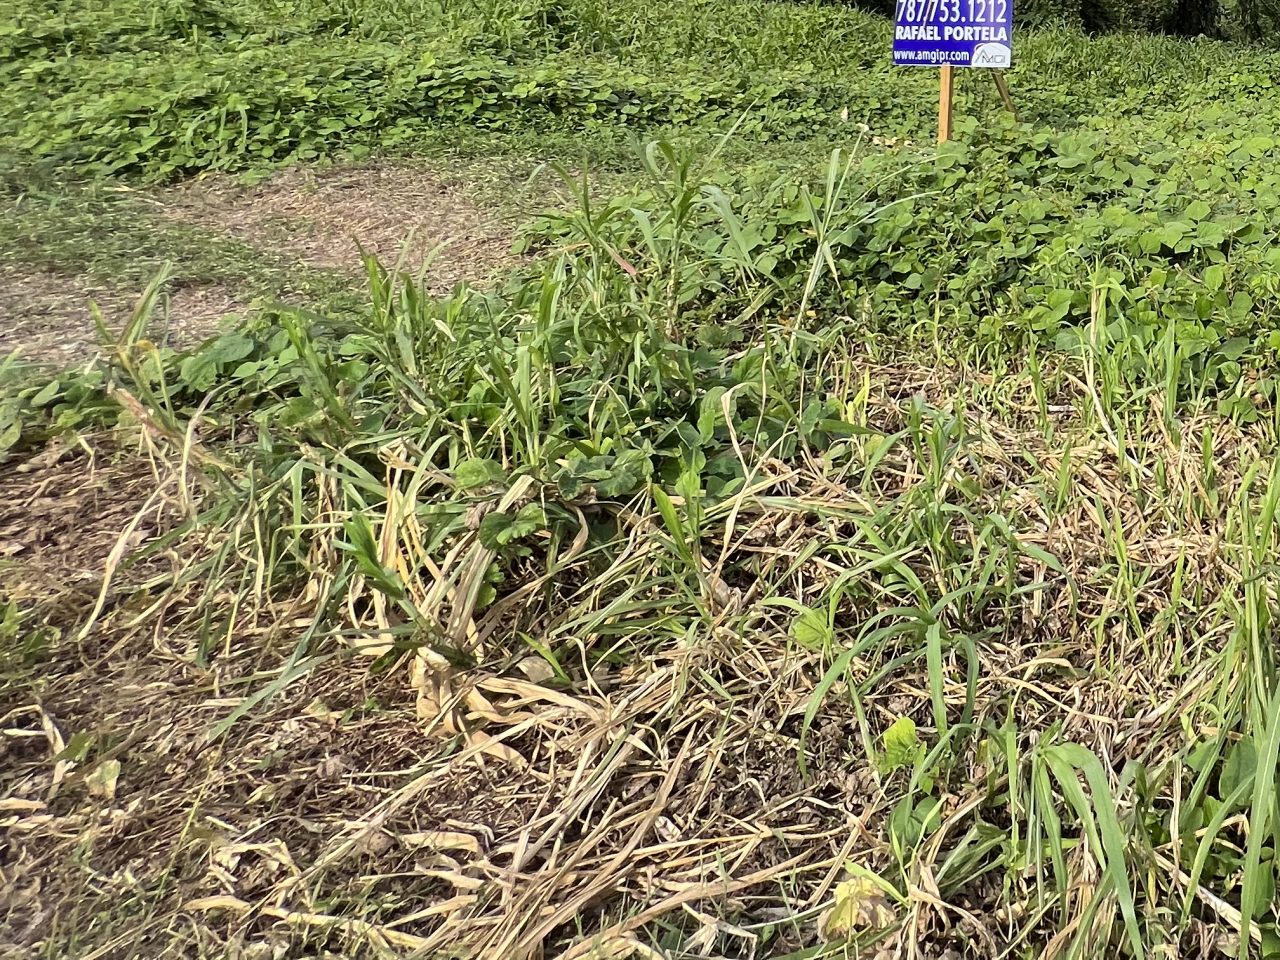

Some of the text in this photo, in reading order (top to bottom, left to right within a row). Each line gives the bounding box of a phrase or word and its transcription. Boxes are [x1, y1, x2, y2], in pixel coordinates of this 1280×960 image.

[895, 25, 1007, 41] RAFAEL PORTELA
[894, 48, 970, 63] www.amgipr.com
